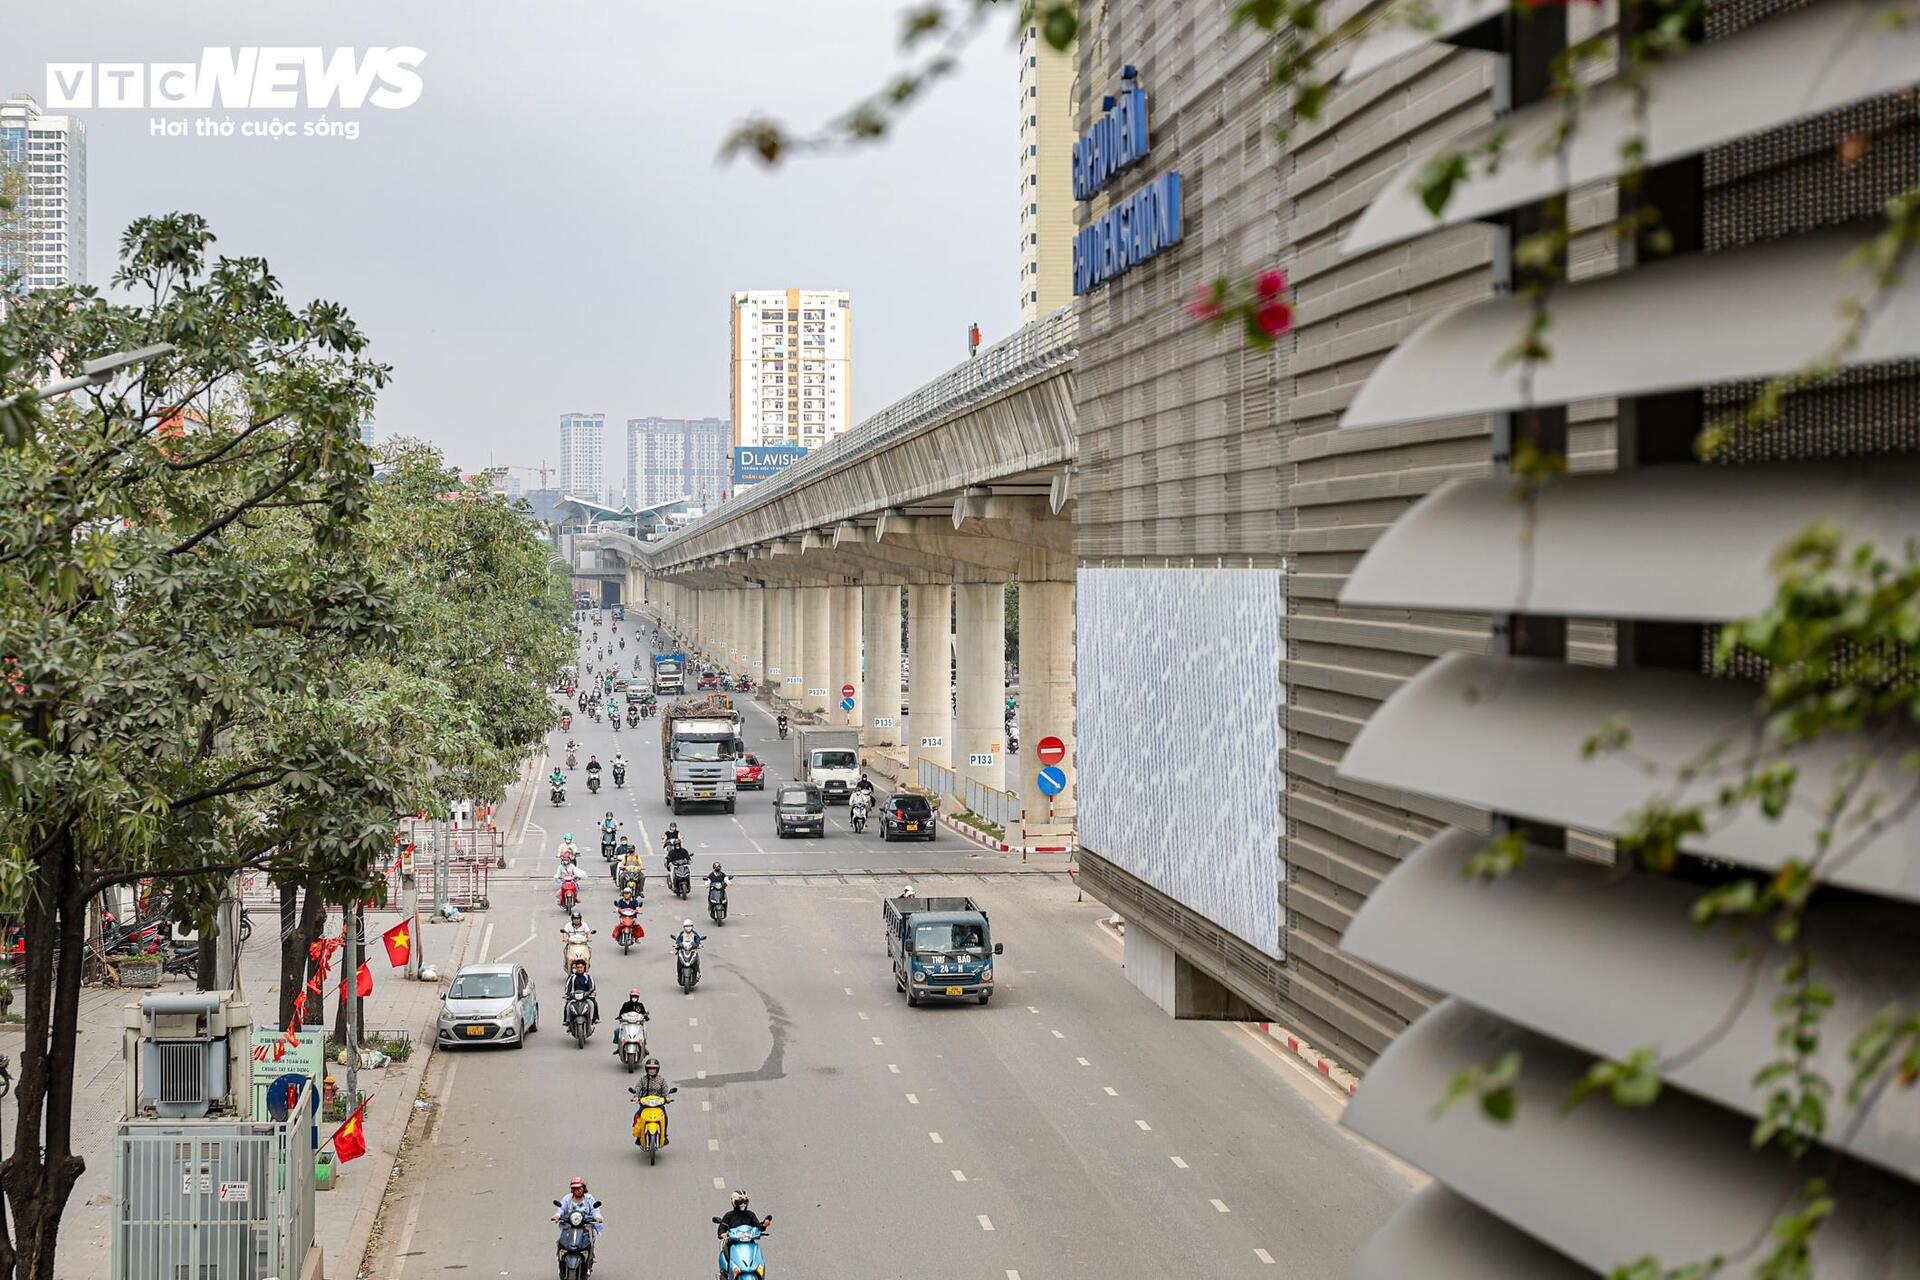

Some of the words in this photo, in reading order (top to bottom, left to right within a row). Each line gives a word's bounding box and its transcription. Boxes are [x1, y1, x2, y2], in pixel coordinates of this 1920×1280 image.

[1119, 171, 1180, 269] STATION
[970, 756, 993, 764] P133
[940, 965, 949, 973] 24
